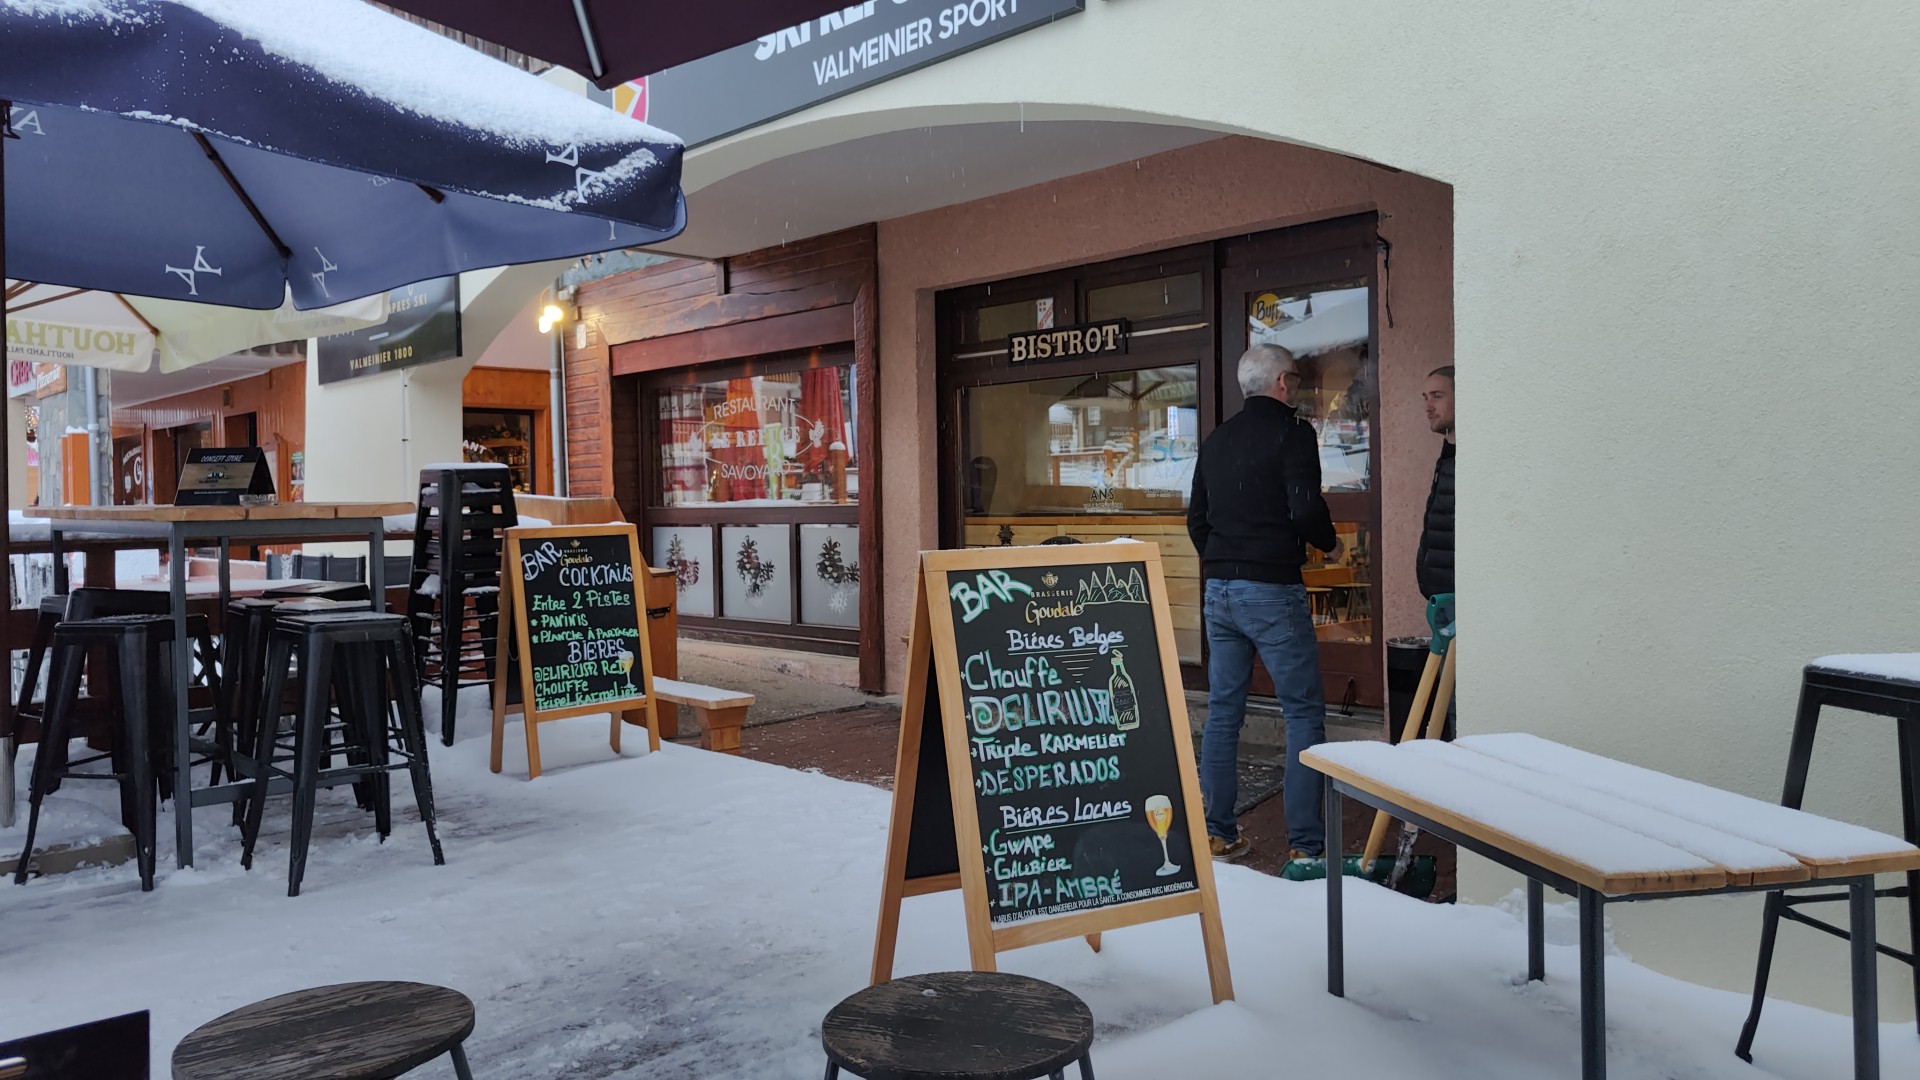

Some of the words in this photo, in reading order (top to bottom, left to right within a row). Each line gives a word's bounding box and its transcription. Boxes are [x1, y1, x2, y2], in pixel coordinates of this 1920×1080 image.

[812, 17, 933, 86] VALMEINIER
[938, 0, 1018, 40] SPORT
[413, 293, 428, 308] SKI
[349, 350, 392, 371] VALMEINIER
[394, 345, 413, 361] 1800
[1011, 324, 1120, 362] BISTROT
[713, 397, 796, 420] RESTAURANT
[735, 426, 801, 448] REFUGE
[721, 460, 791, 481] SAVOYARD
[521, 541, 562, 581] BAR
[571, 591, 583, 609] 2
[949, 569, 1034, 623] BAR
[1030, 589, 1074, 598] BRASSERIE
[1025, 600, 1084, 626] Goudale
[1068, 622, 1125, 655] Belges
[964, 649, 1063, 691] Chouffe
[969, 686, 1117, 735] DELIRIUM
[979, 755, 1121, 797] DESPERADOS
[1037, 906, 1047, 915] EST
[1048, 901, 1079, 914] DANGEREUX
[1078, 899, 1092, 909] POUR
[1092, 898, 1099, 907] LA
[1120, 888, 1151, 901] CONSOMMER
[1151, 885, 1164, 895] AVEC
